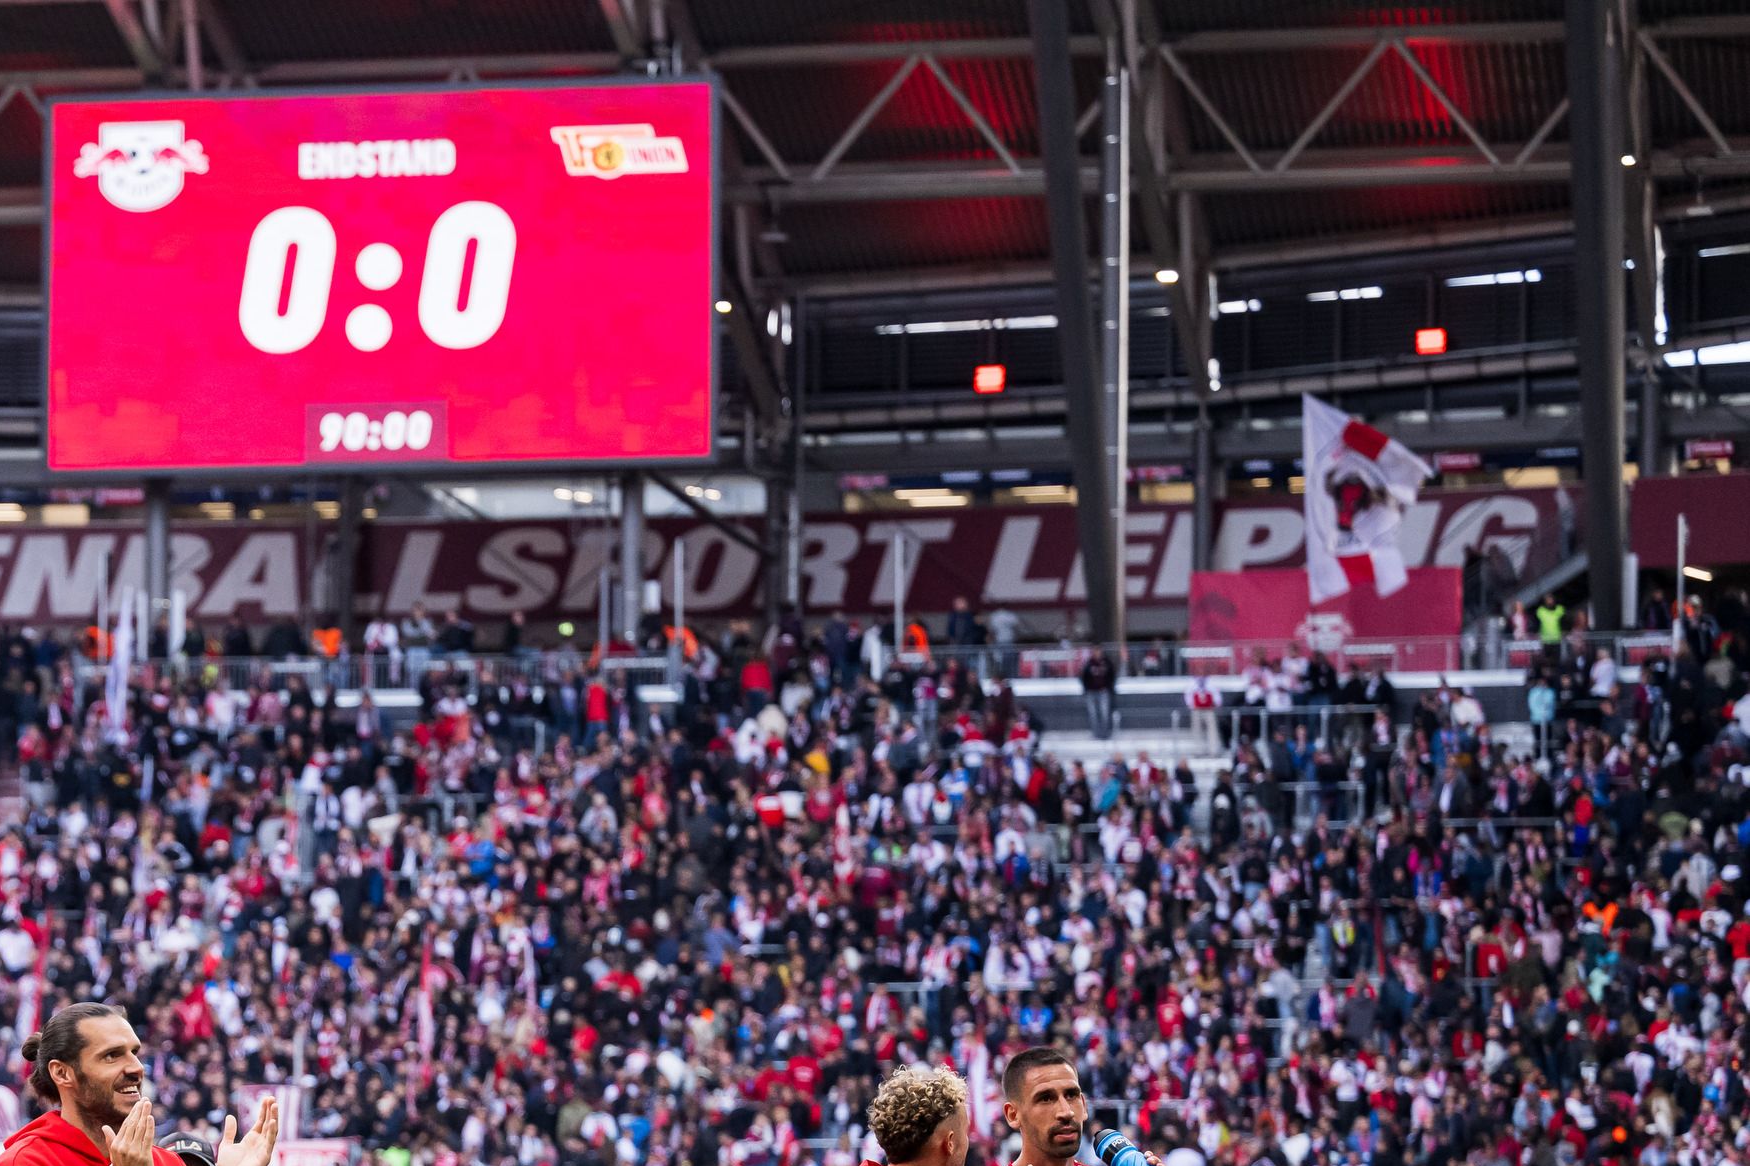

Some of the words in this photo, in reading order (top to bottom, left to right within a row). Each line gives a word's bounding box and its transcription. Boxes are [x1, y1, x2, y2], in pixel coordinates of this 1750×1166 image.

[297, 139, 456, 179] ENDSTAND
[238, 200, 518, 354] 0:0
[318, 410, 434, 452] 90:00
[983, 497, 1540, 602] LEIPIG
